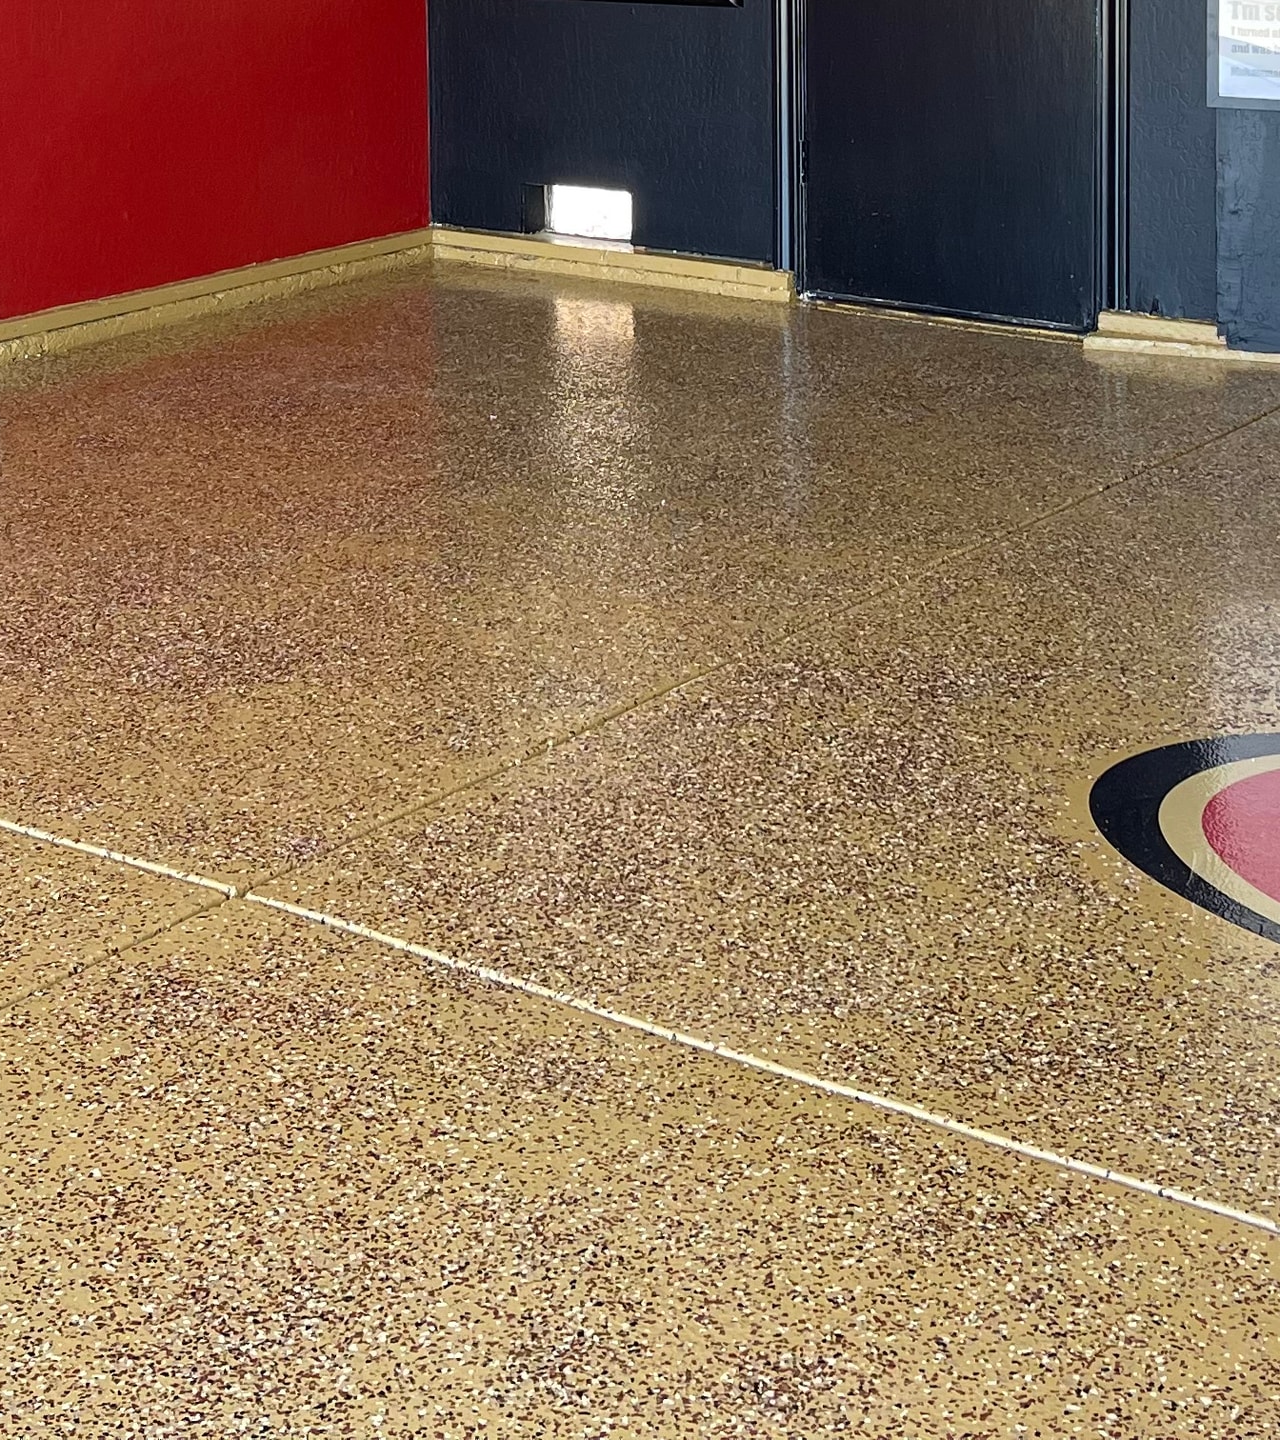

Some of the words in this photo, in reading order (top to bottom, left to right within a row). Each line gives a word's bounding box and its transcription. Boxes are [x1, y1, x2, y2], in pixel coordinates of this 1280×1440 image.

[1237, 27, 1270, 37] turned
[1231, 43, 1250, 54] and
[1251, 44, 1271, 55] was
